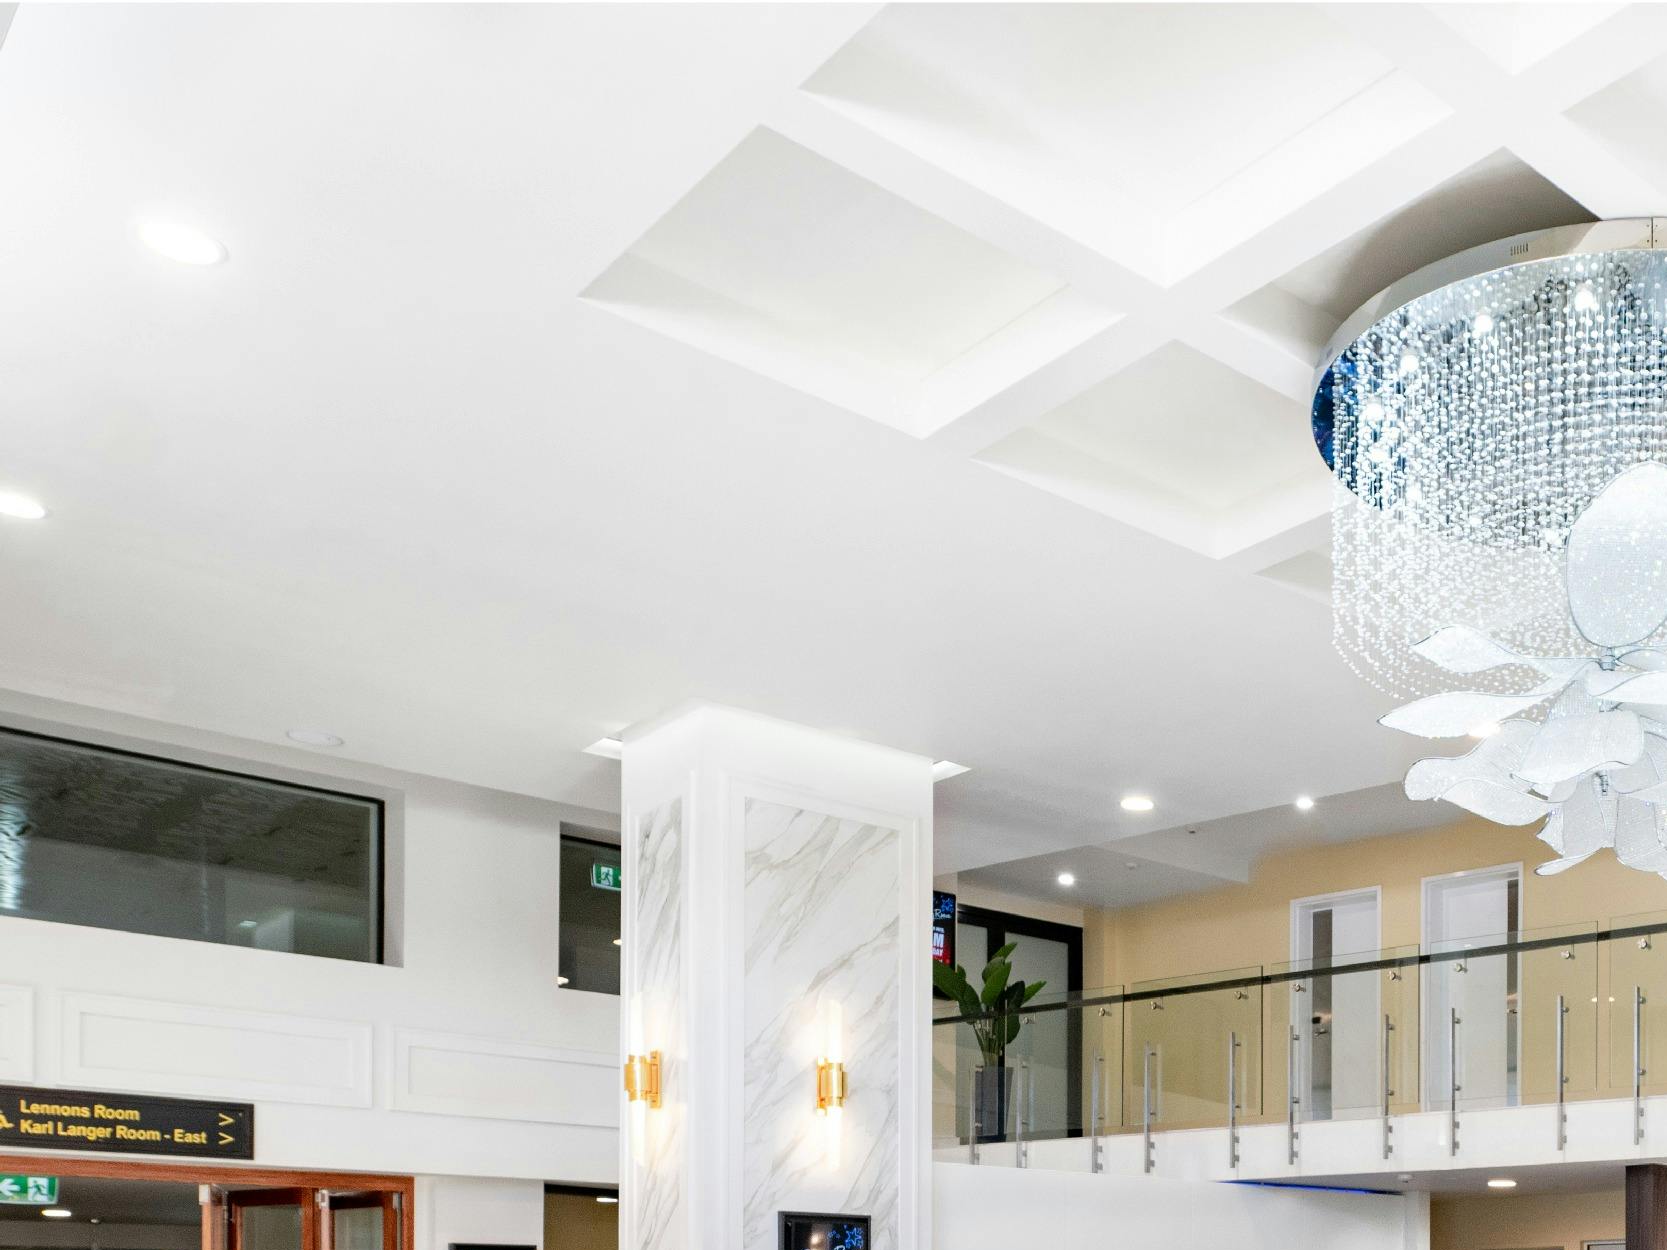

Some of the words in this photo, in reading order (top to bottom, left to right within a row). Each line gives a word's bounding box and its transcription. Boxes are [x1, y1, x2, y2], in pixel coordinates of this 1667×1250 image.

[20, 1099, 90, 1118] Lennons
[94, 1104, 140, 1121] Room
[20, 1119, 53, 1136] Karl
[57, 1123, 112, 1141] Langer
[116, 1126, 161, 1142] Room
[173, 1129, 207, 1145] East
